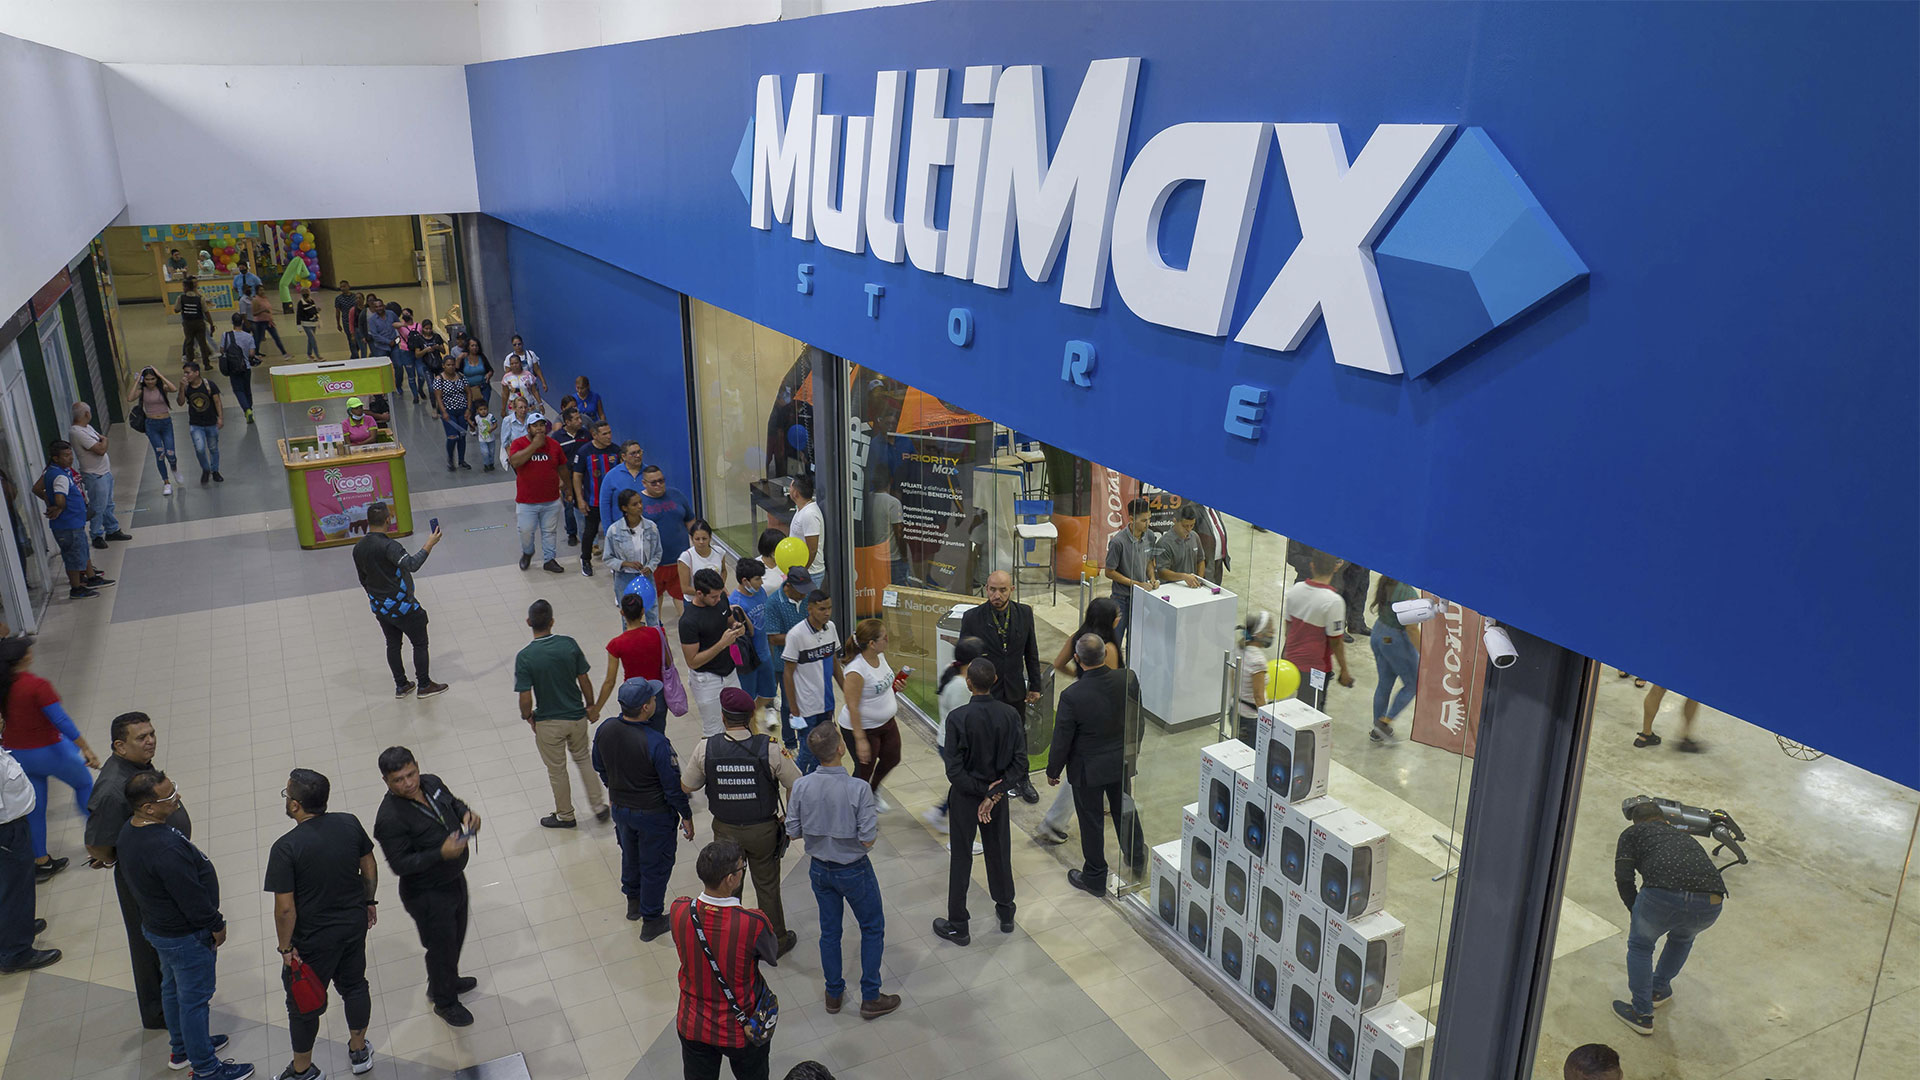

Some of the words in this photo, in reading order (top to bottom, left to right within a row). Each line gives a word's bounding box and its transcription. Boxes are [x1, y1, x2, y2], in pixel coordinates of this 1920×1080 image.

[751, 57, 1458, 375] MultiMax
[797, 263, 1269, 440] STORE
[902, 453, 960, 465] PRIORITY
[932, 464, 955, 475] Max
[339, 477, 370, 489] COCO
[928, 492, 962, 500] BENEFICIOS
[903, 505, 936, 514] Promociones
[903, 535, 937, 543] Acumulación
[922, 530, 949, 538] prioritario
[1274, 803, 1286, 814] JVC
[1314, 828, 1326, 840] JVC
[1329, 918, 1342, 931] JVC
[1283, 960, 1294, 972] JVC
[1322, 991, 1335, 1003] JVC
[1364, 1024, 1377, 1036] JVC
